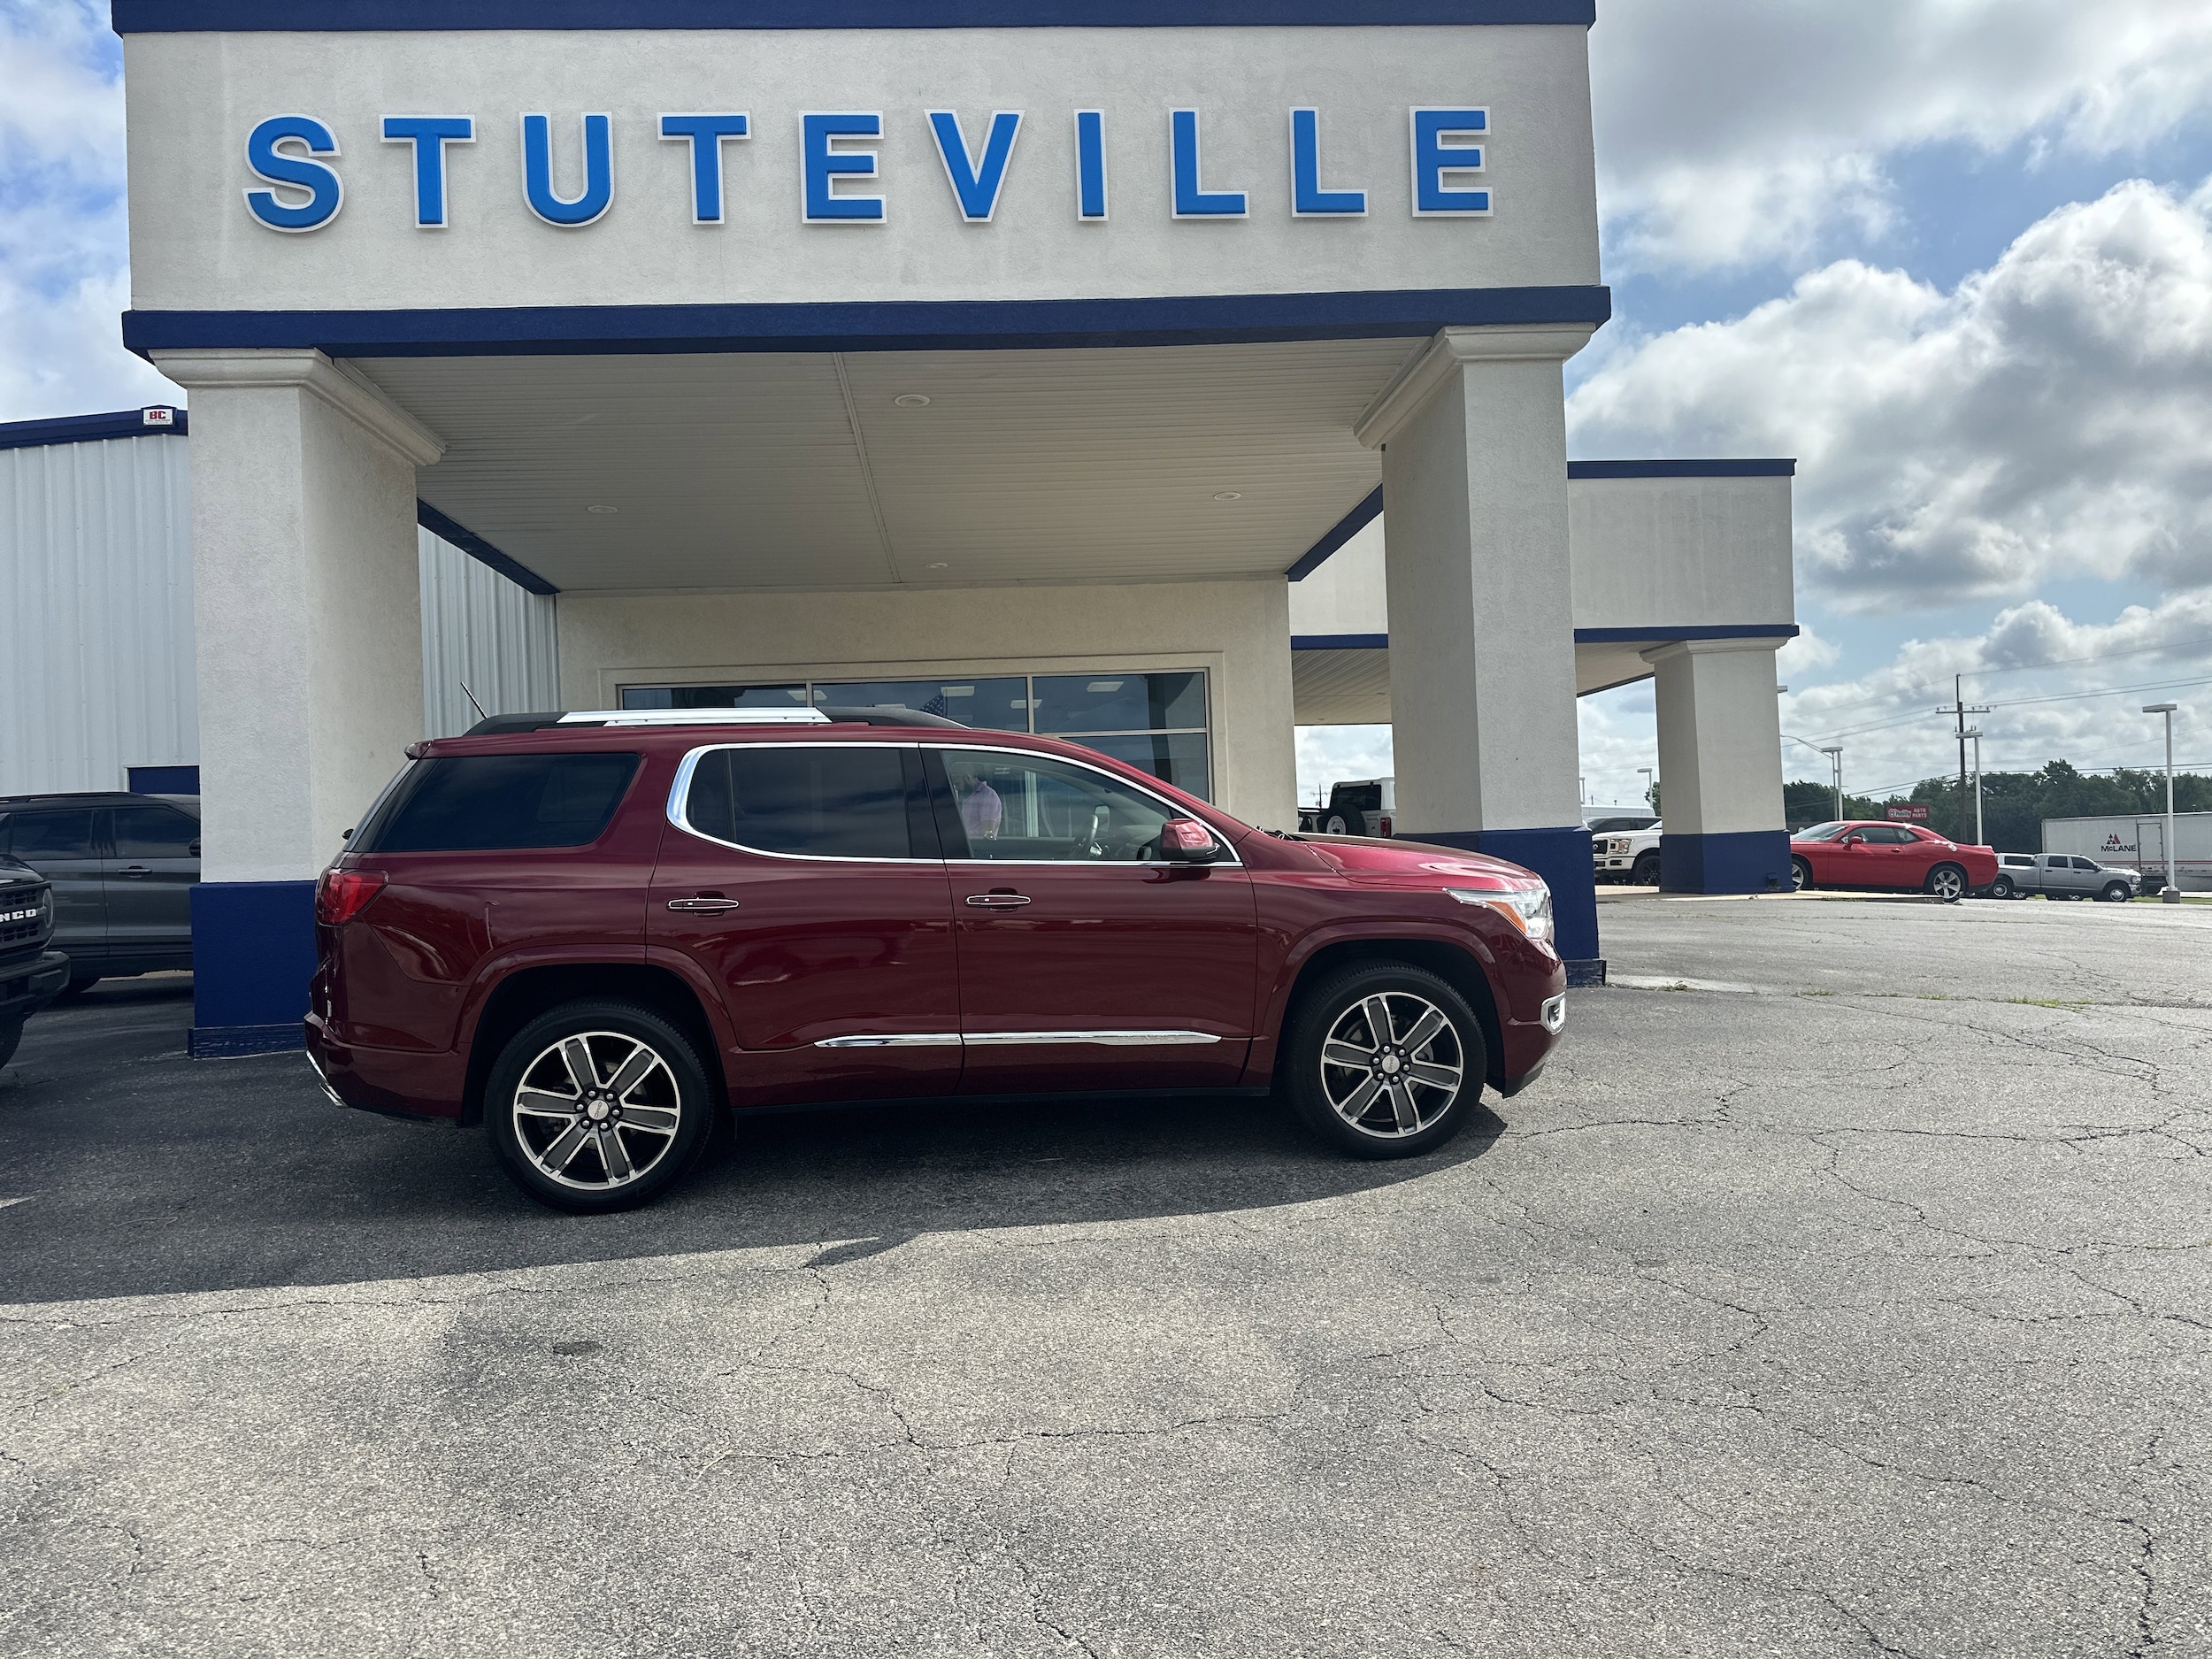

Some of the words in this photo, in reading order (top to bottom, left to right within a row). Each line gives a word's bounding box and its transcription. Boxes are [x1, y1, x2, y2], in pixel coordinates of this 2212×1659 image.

[242, 106, 1494, 233] STUTEVILLE
[150, 411, 166, 419] BC
[594, 1101, 603, 1119] GMC
